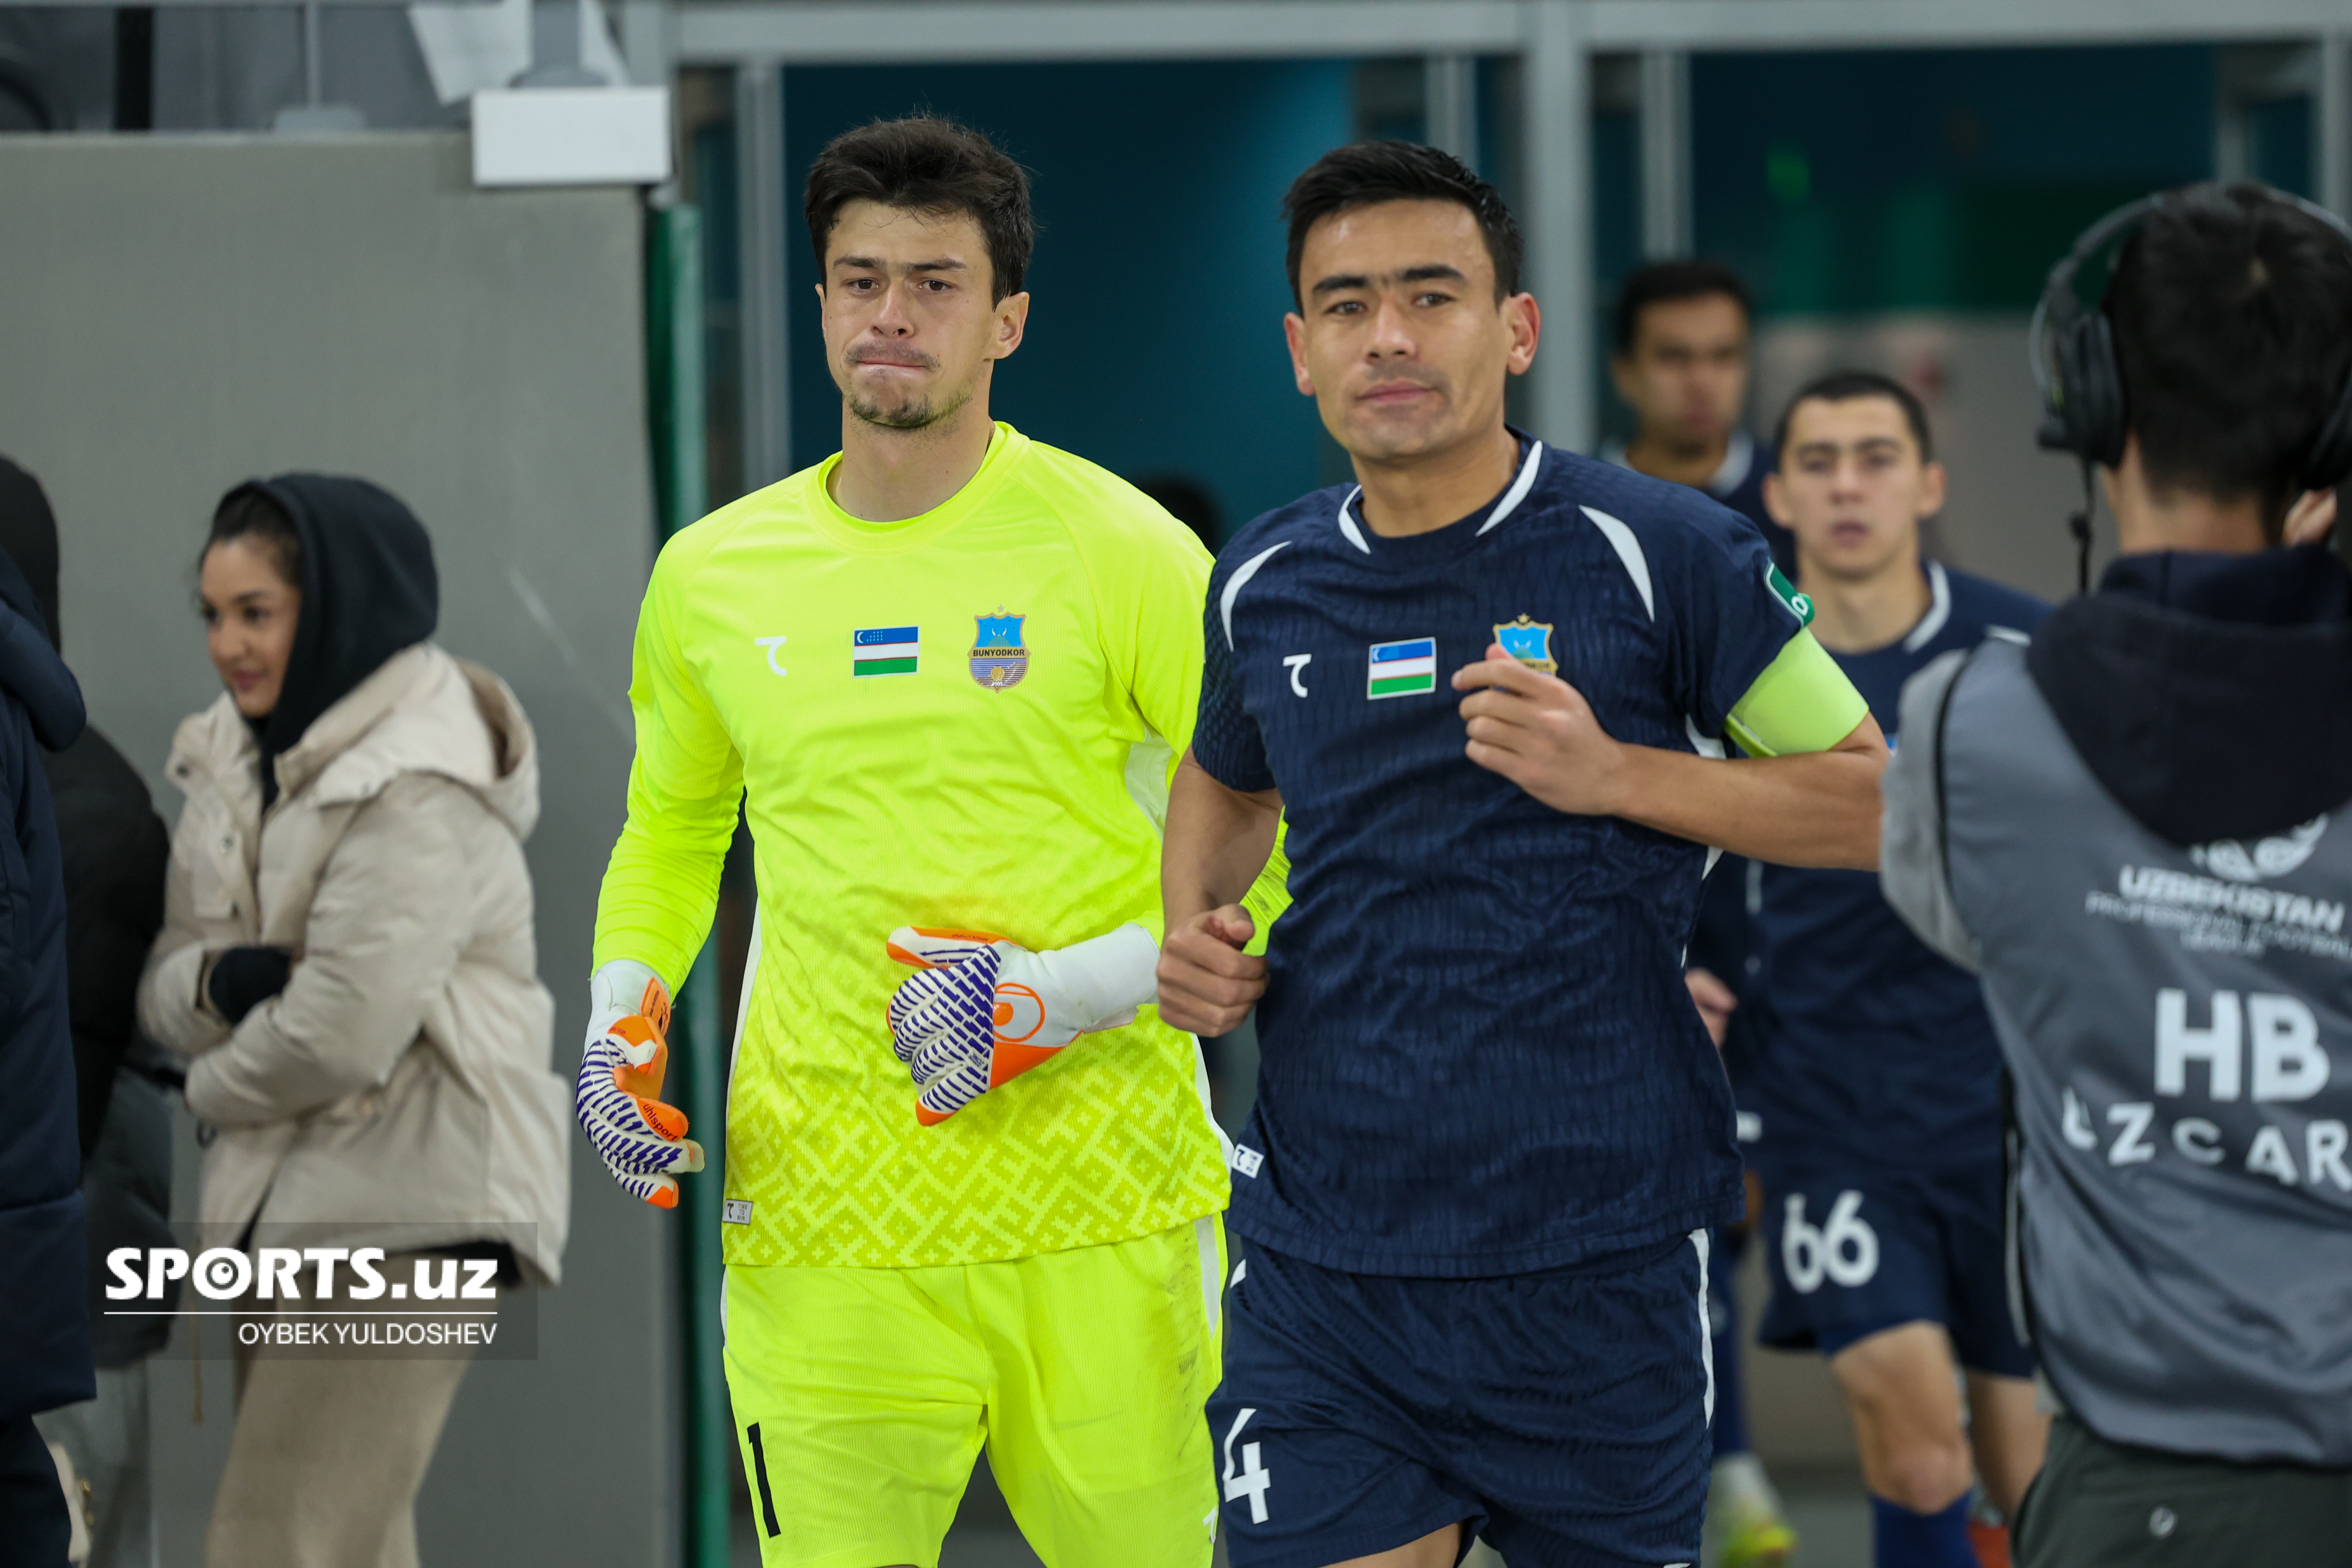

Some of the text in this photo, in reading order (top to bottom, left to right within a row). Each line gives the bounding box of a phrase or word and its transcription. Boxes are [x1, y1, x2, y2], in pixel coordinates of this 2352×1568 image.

[2154, 987, 2331, 1103] HB
[643, 1104, 678, 1141] uhlsport
[1781, 1189, 1880, 1294] 66
[747, 1421, 782, 1538] 1
[1221, 1407, 1271, 1524] 4
